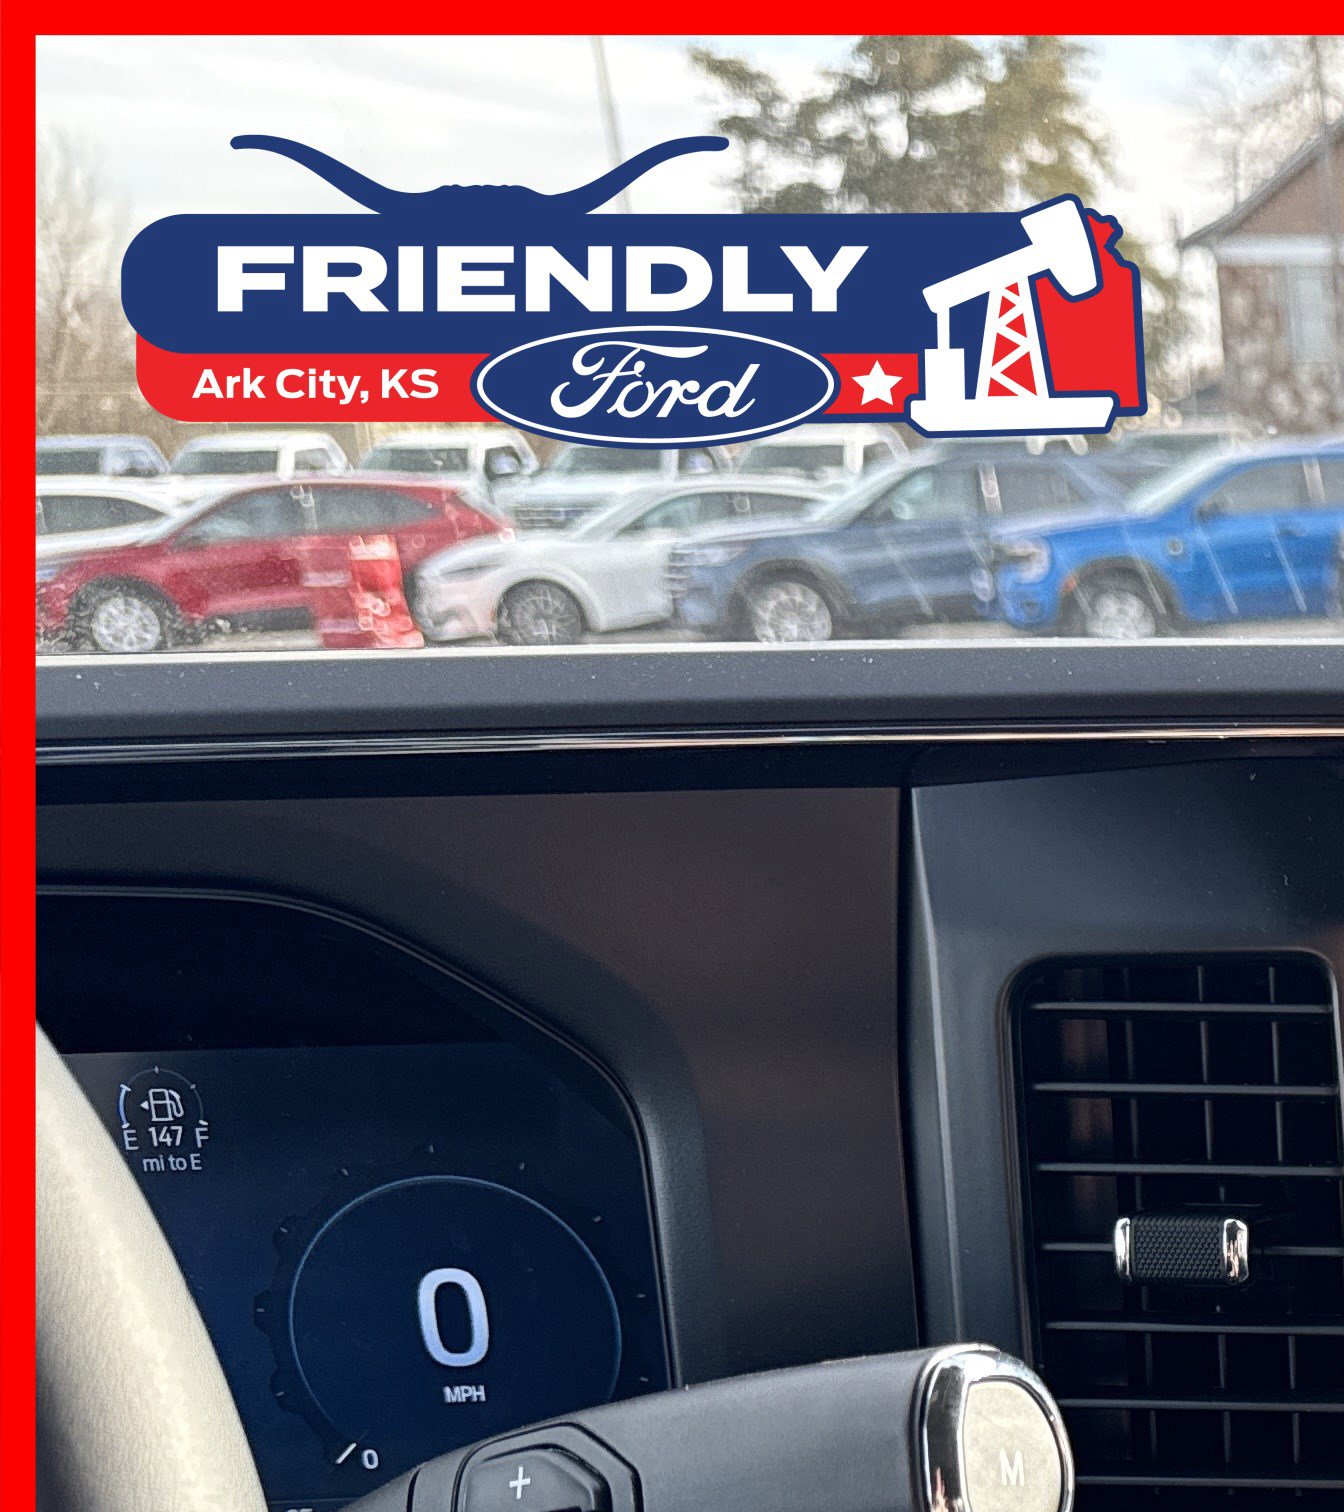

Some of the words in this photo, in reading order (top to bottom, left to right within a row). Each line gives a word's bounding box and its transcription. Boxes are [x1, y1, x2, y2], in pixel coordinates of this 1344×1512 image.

[123, 1129, 139, 1150] E
[148, 1125, 183, 1147] 147
[195, 1127, 209, 1148] F
[142, 1155, 165, 1172] mi
[168, 1154, 188, 1171] to
[190, 1153, 202, 1170] E
[417, 1267, 490, 1367] 0
[443, 1384, 487, 1403] MPH
[361, 1448, 379, 1470] 0
[1000, 1448, 1025, 1486] M
